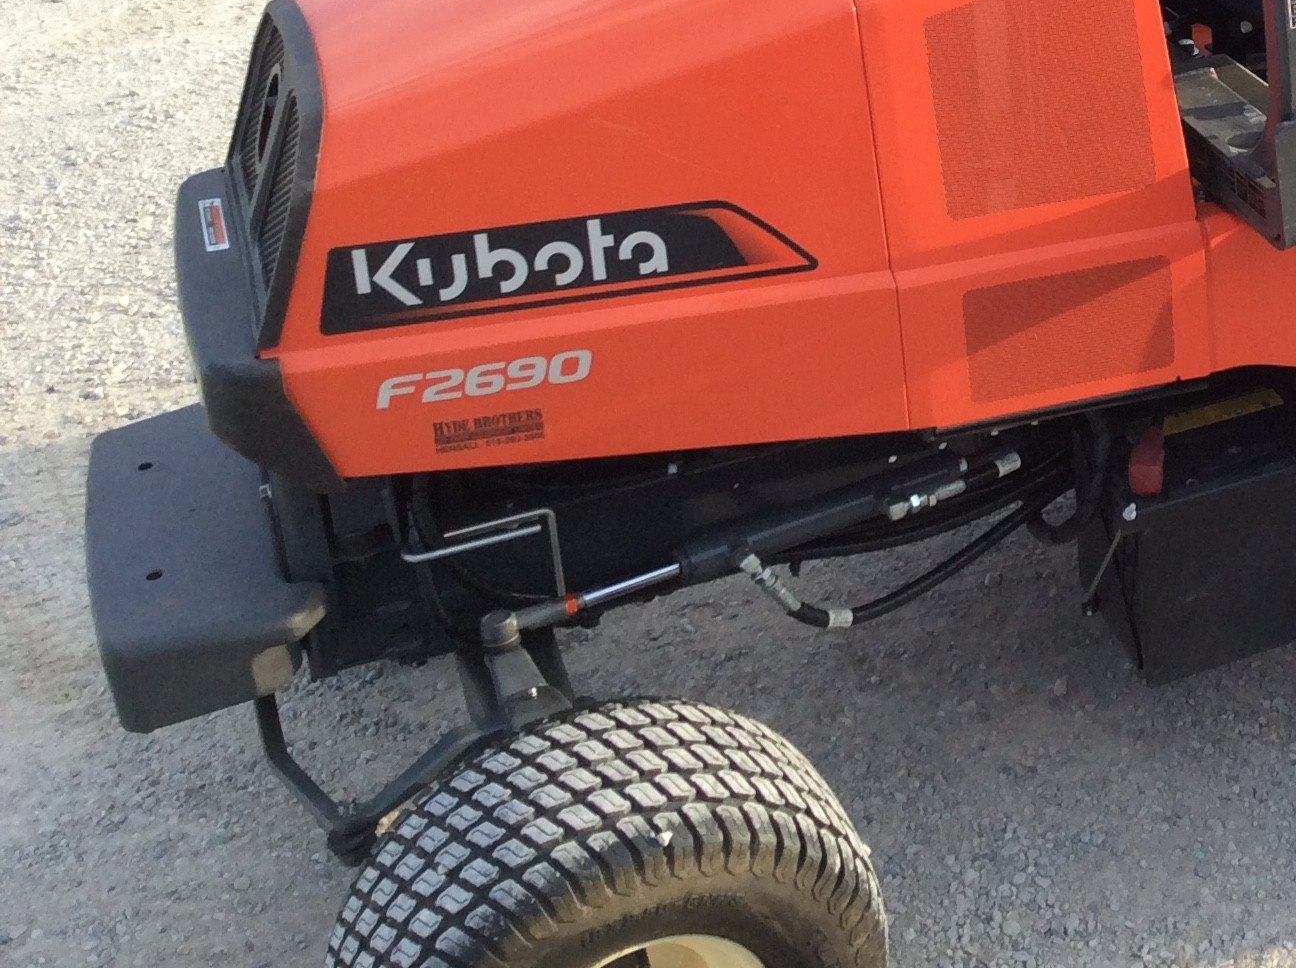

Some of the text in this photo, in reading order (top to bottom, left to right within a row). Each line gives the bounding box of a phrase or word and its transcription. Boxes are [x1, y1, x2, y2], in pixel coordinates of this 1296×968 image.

[352, 219, 669, 306] Kubota
[375, 349, 592, 410] F2690
[432, 419, 469, 436] HYDE
[473, 408, 543, 429] BROTHERS
